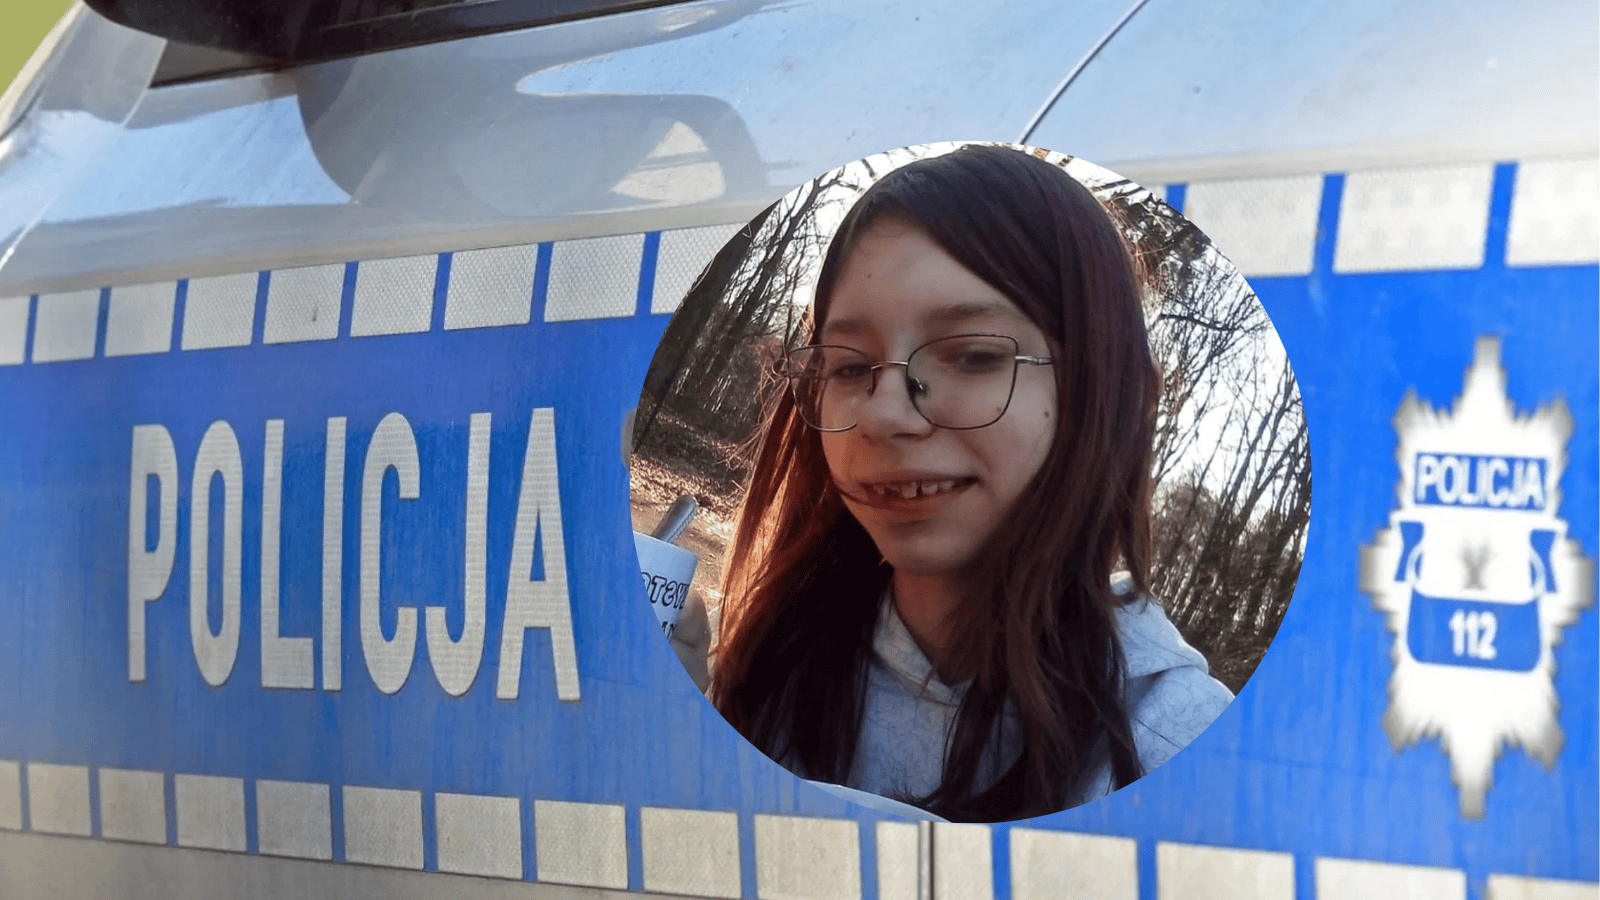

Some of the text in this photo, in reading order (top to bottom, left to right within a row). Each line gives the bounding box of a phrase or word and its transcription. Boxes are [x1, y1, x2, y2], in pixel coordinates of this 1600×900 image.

[1417, 455, 1545, 508] POLICJA
[128, 408, 581, 701] POLICJA
[1449, 609, 1498, 660] 112
